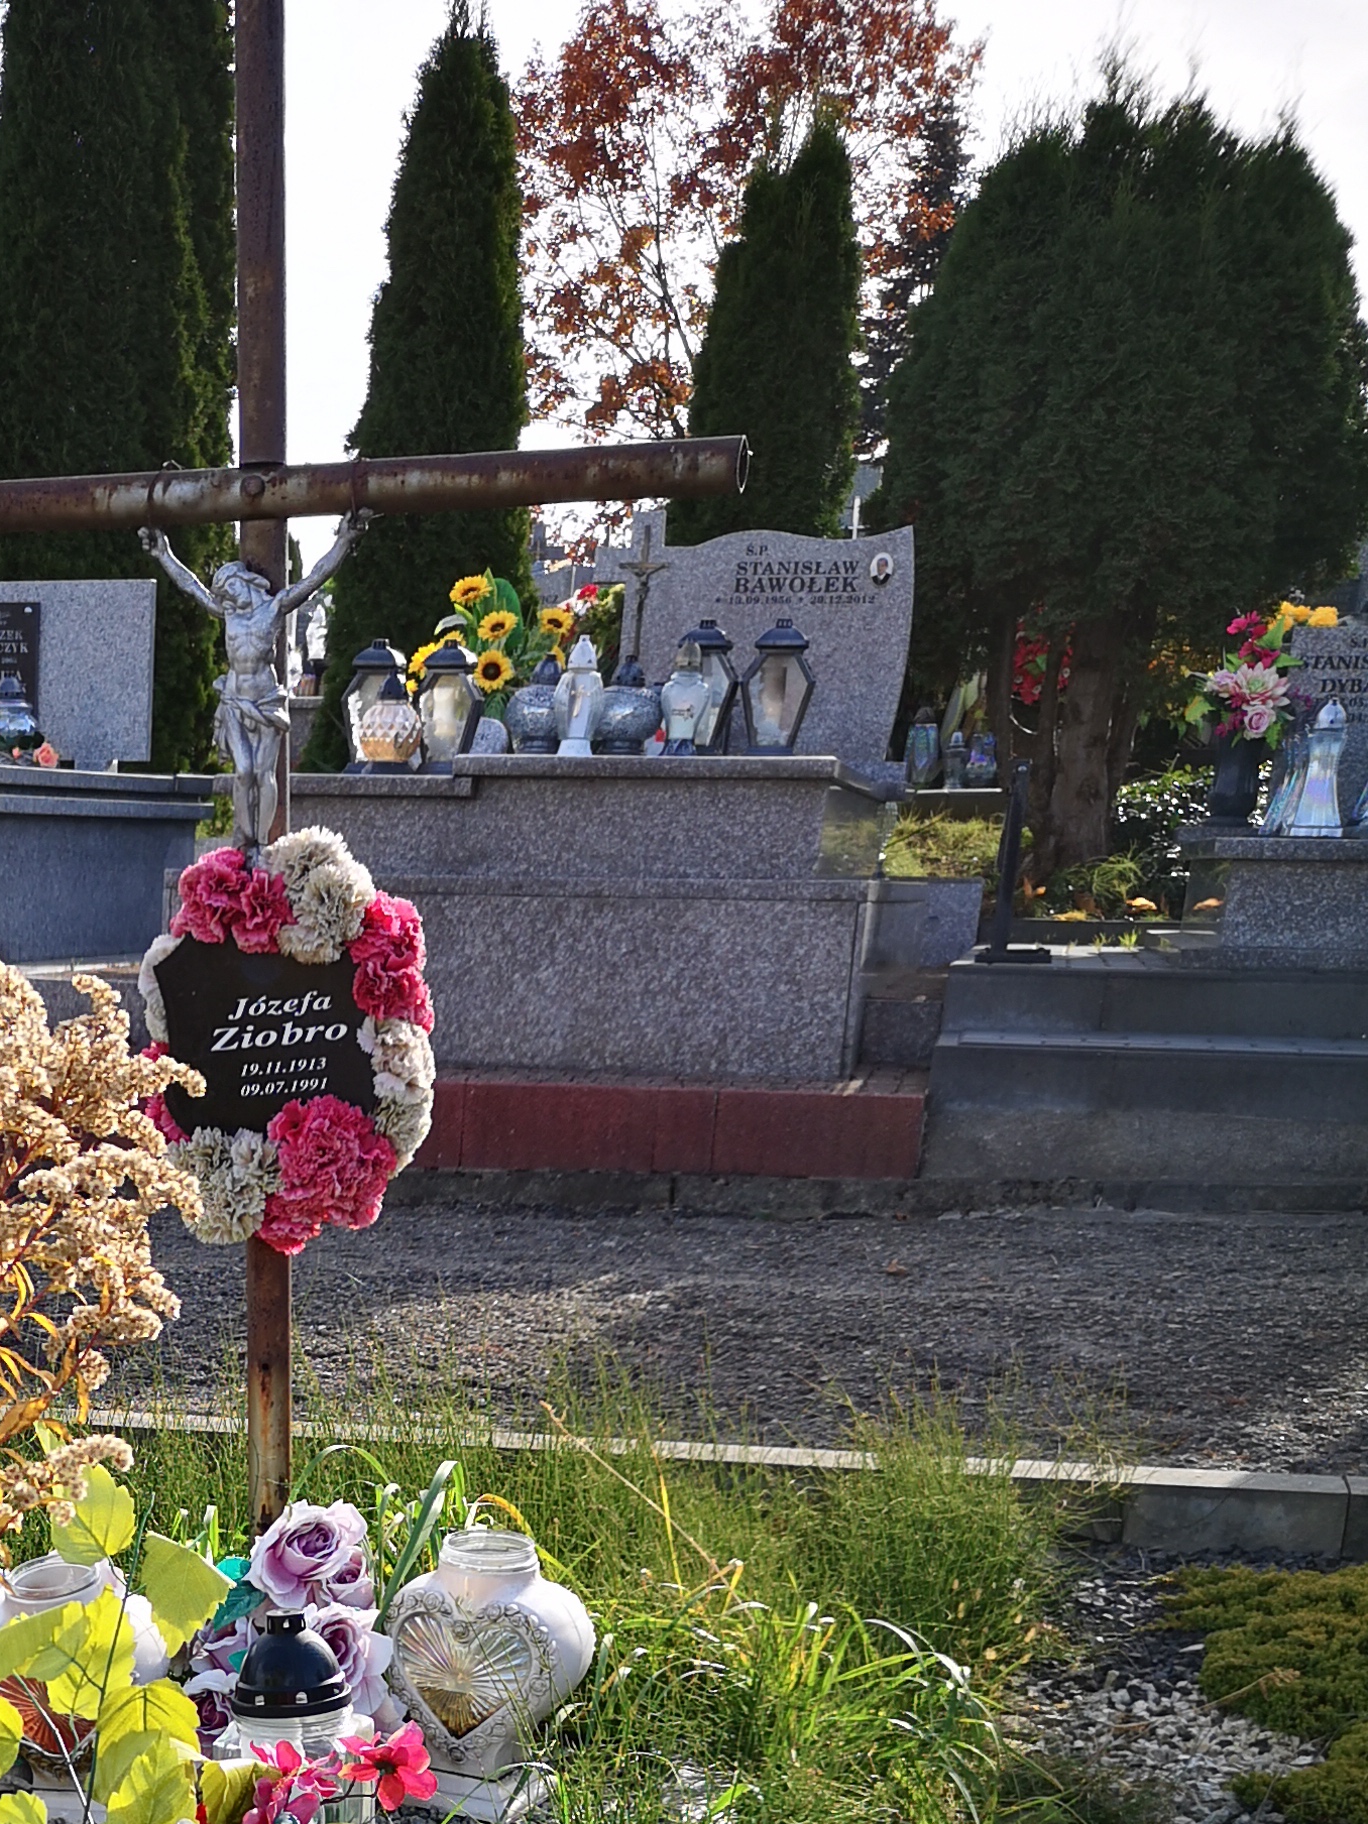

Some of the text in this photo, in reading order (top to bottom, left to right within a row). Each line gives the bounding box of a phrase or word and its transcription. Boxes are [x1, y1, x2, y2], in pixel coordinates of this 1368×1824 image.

[736, 560, 859, 576] STANISŁAW
[734, 576, 858, 594] BAWOŁEK
[228, 990, 332, 1021] Józefa
[210, 1021, 348, 1052] Ziobro
[241, 1057, 327, 1078] 19.11.1913
[240, 1077, 328, 1097] 09.07.1991
